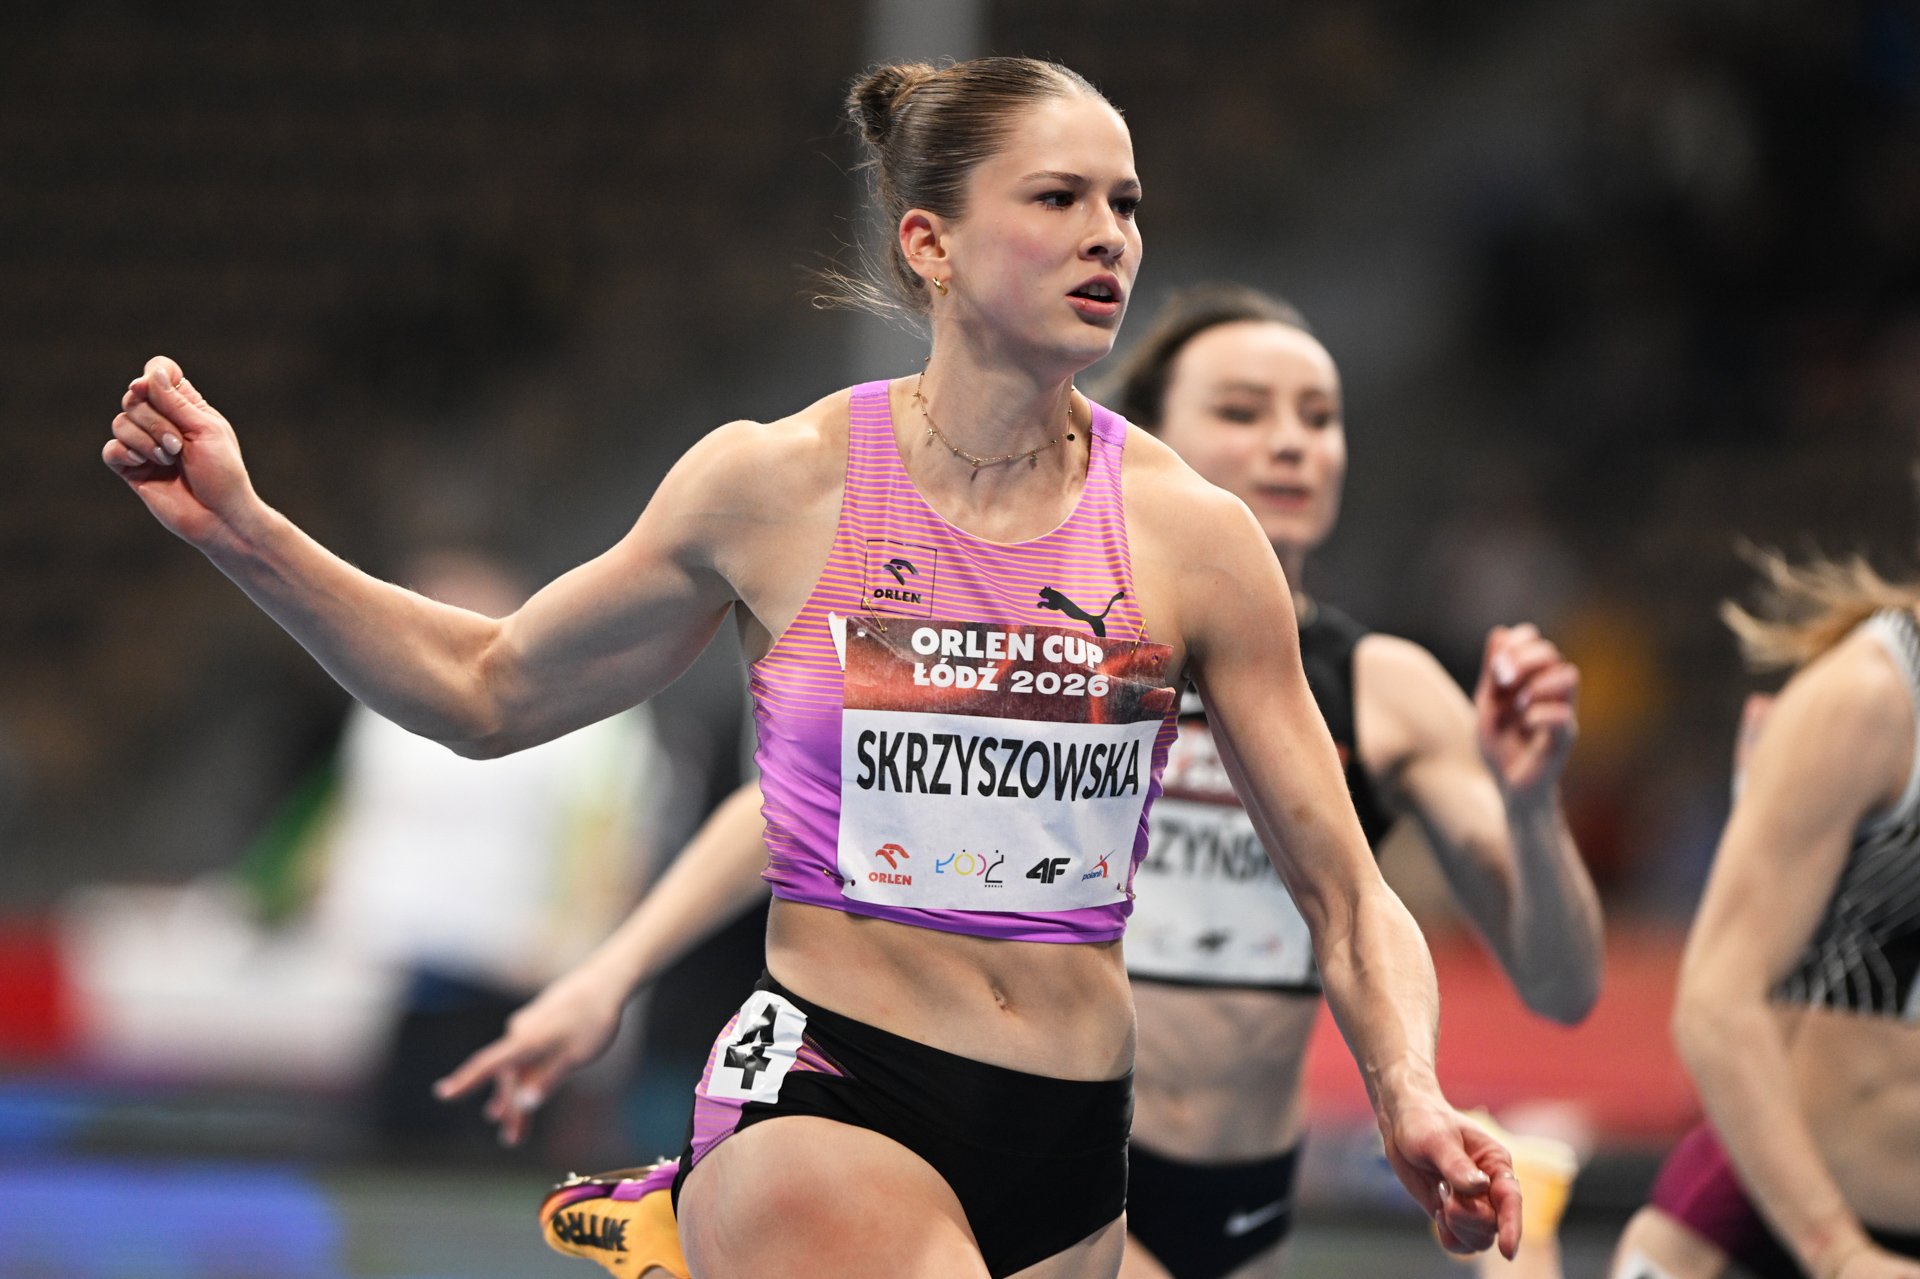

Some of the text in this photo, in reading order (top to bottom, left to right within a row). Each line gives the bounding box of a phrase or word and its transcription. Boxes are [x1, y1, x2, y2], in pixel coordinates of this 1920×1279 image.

[873, 588, 922, 604] ORLEN
[911, 626, 1104, 669] ORLEN CUP
[912, 656, 1110, 698] ŁÓDŹ 2026
[855, 729, 1140, 803] SKRZYSZOWSKA
[868, 871, 913, 886] ORLEN
[1025, 857, 1071, 884] 4F
[723, 1002, 781, 1091] 4
